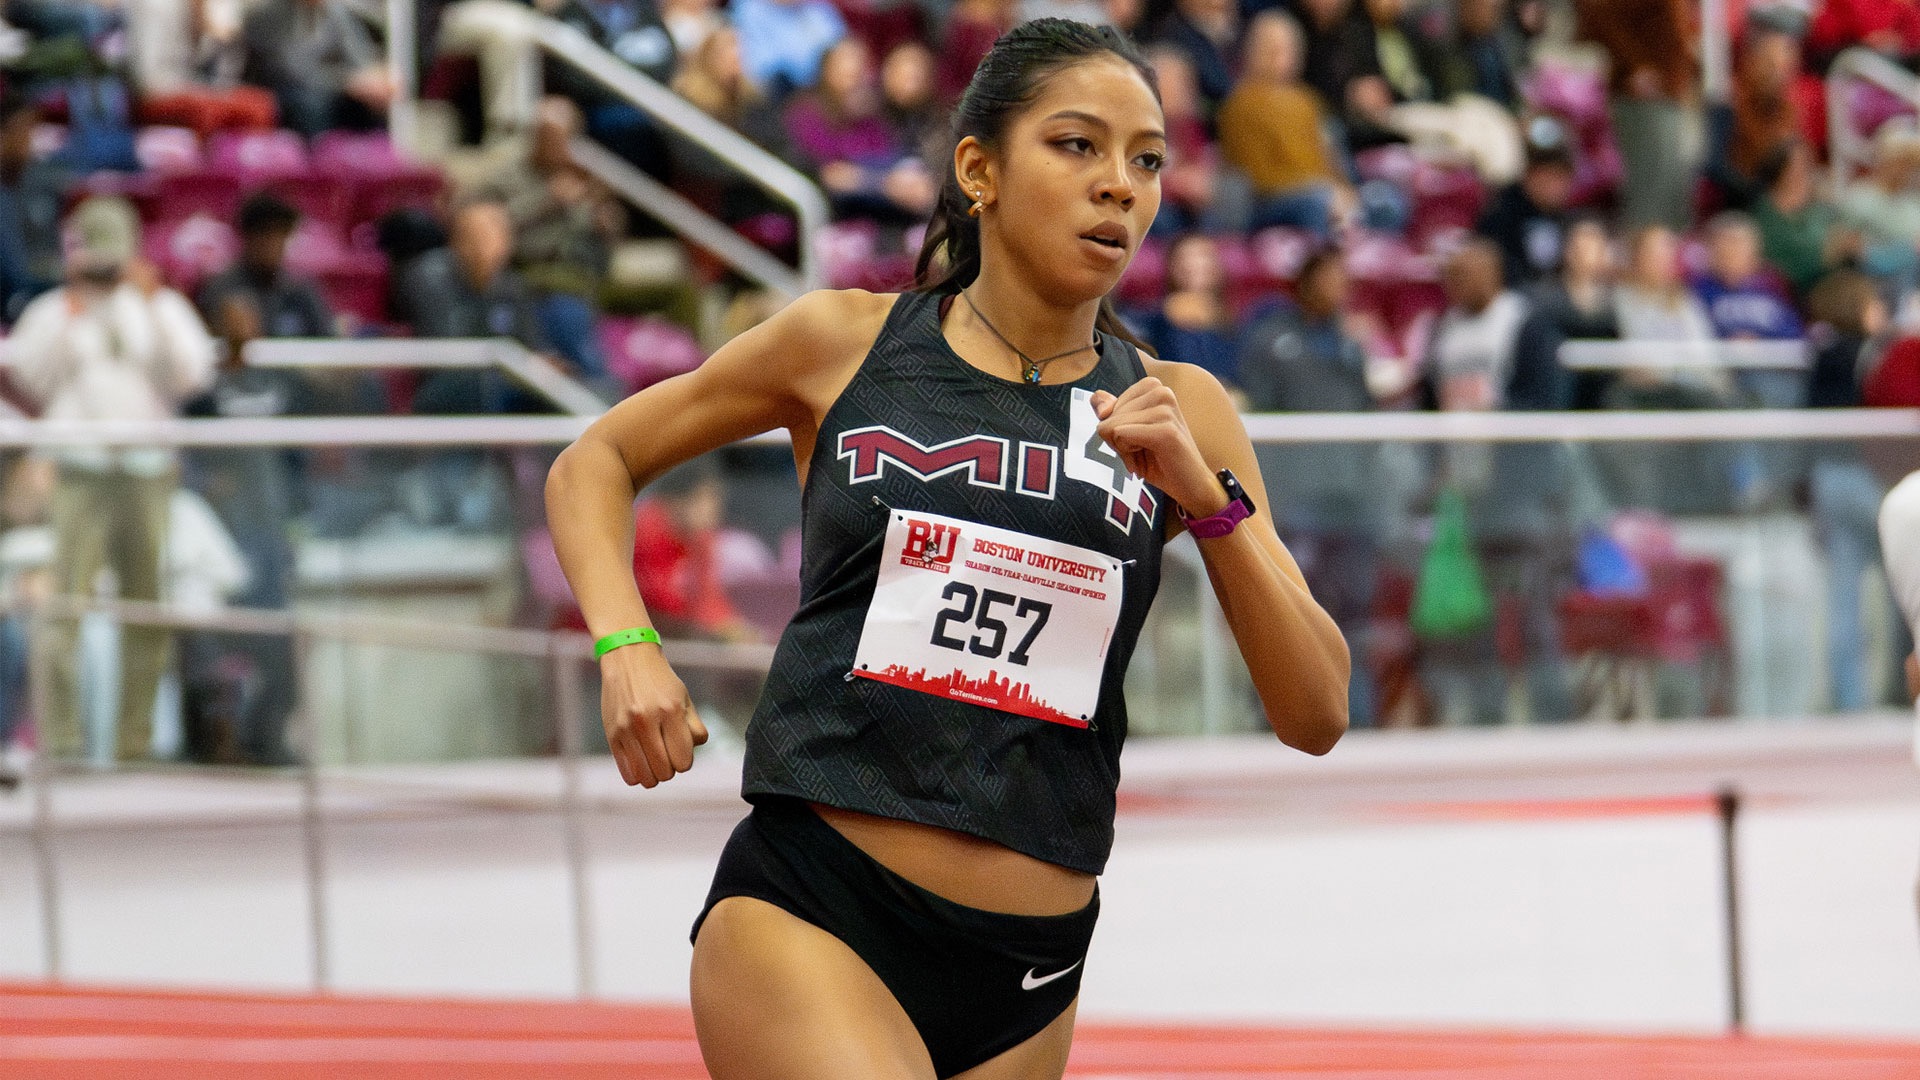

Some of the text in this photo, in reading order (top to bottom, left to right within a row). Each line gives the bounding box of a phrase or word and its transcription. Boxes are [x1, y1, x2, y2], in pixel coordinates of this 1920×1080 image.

[902, 519, 961, 563] BU
[973, 539, 1107, 583] BOSTON UNIVERSITY
[904, 557, 925, 567] TRACK
[930, 563, 948, 573] FIELD
[964, 560, 991, 572] SHARON
[1056, 582, 1081, 595] SEASON
[1081, 589, 1107, 601] OPENER
[930, 580, 1053, 666] 257
[949, 688, 998, 705] GoTerriers.com
